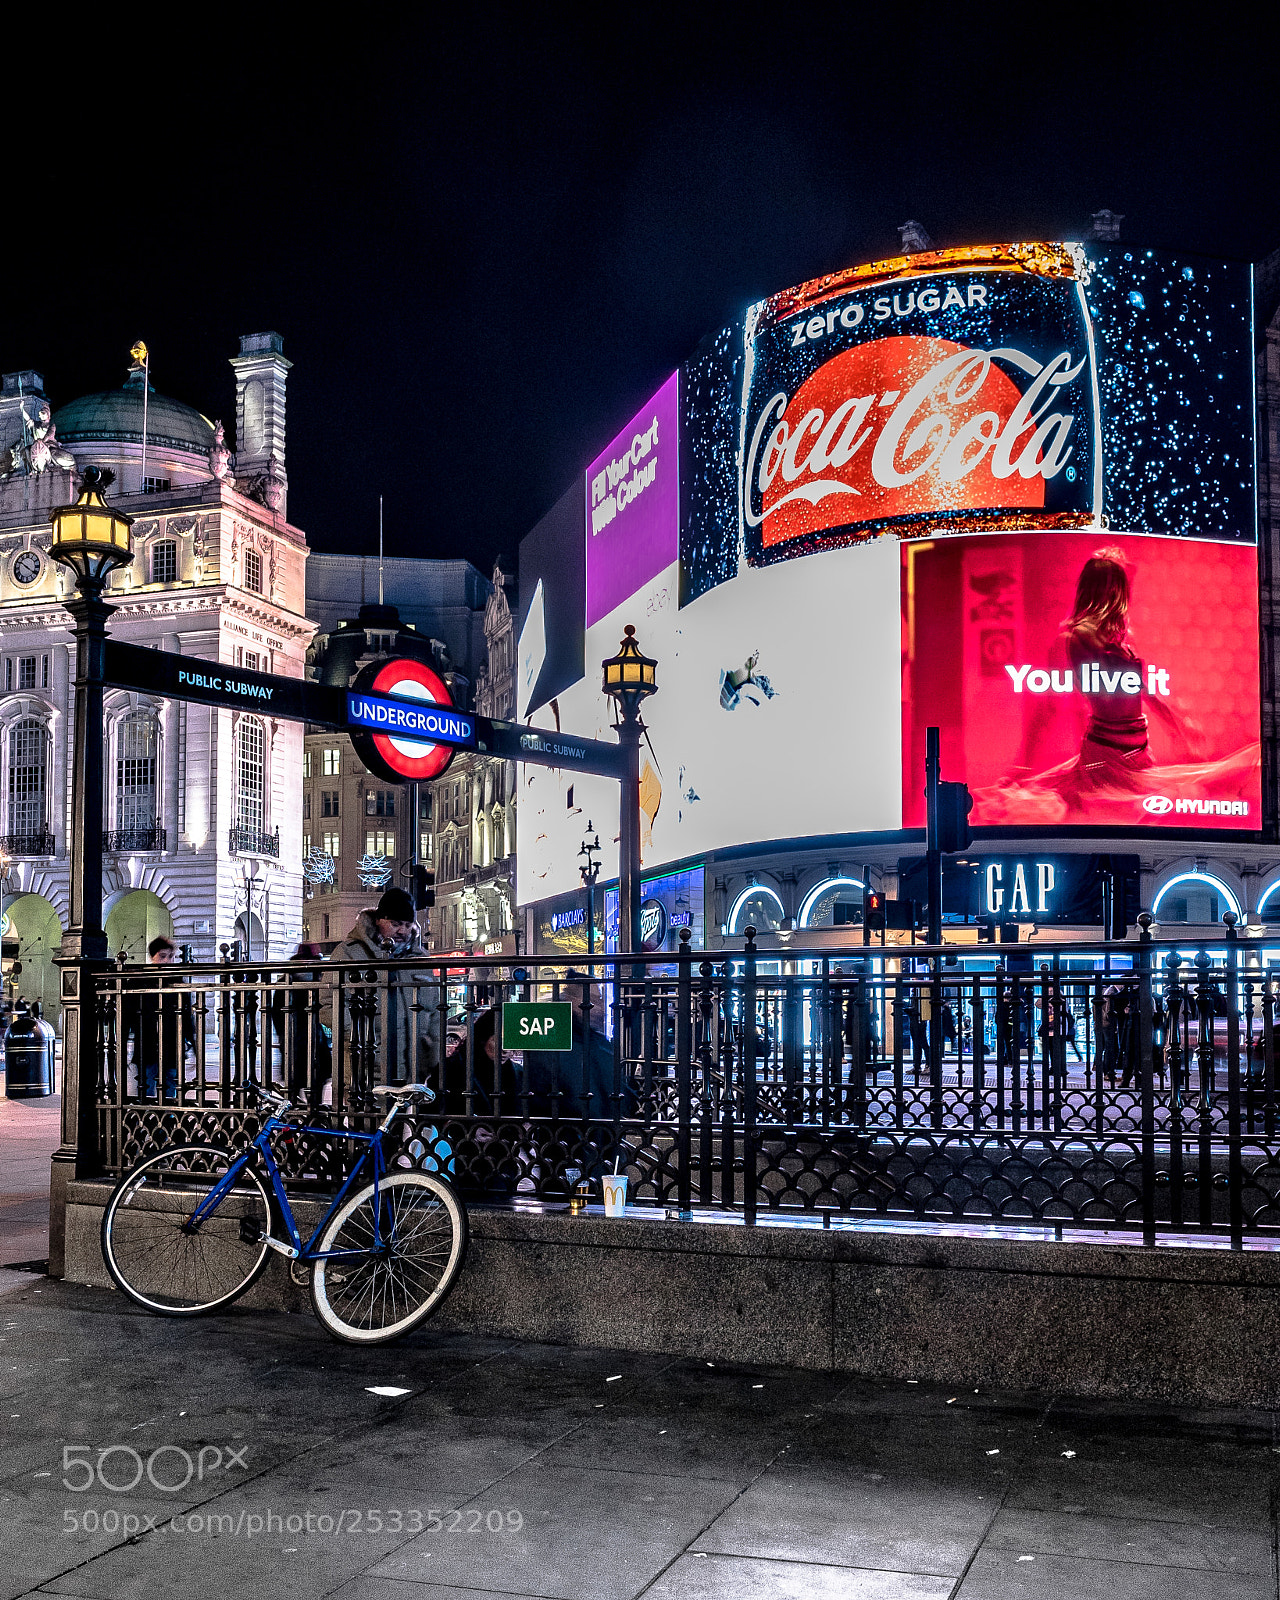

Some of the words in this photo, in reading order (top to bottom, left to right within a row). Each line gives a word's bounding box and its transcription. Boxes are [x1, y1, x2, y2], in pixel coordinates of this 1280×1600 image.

[790, 303, 865, 347] zero
[874, 284, 988, 321] SUGAR
[606, 450, 631, 491] Your
[630, 415, 659, 466] Cart
[745, 348, 1087, 527] Coca-Cola
[223, 620, 249, 636] ALLIANCE
[252, 631, 263, 642] LIFE
[266, 637, 284, 650] OFFICE
[178, 670, 222, 690] PUBLIC
[224, 680, 274, 700] SUBWAY
[1004, 664, 1074, 693] You
[1081, 663, 1142, 695] live
[1147, 665, 1171, 696] it
[350, 700, 471, 738] UNDERGROUND
[522, 738, 552, 754] PUBLIC
[553, 743, 586, 759] SUBWAY
[1175, 798, 1249, 816] HYUNDAI
[986, 863, 1055, 913] GAP
[557, 908, 584, 928] BARCLAYS
[519, 1017, 555, 1036] SAP
